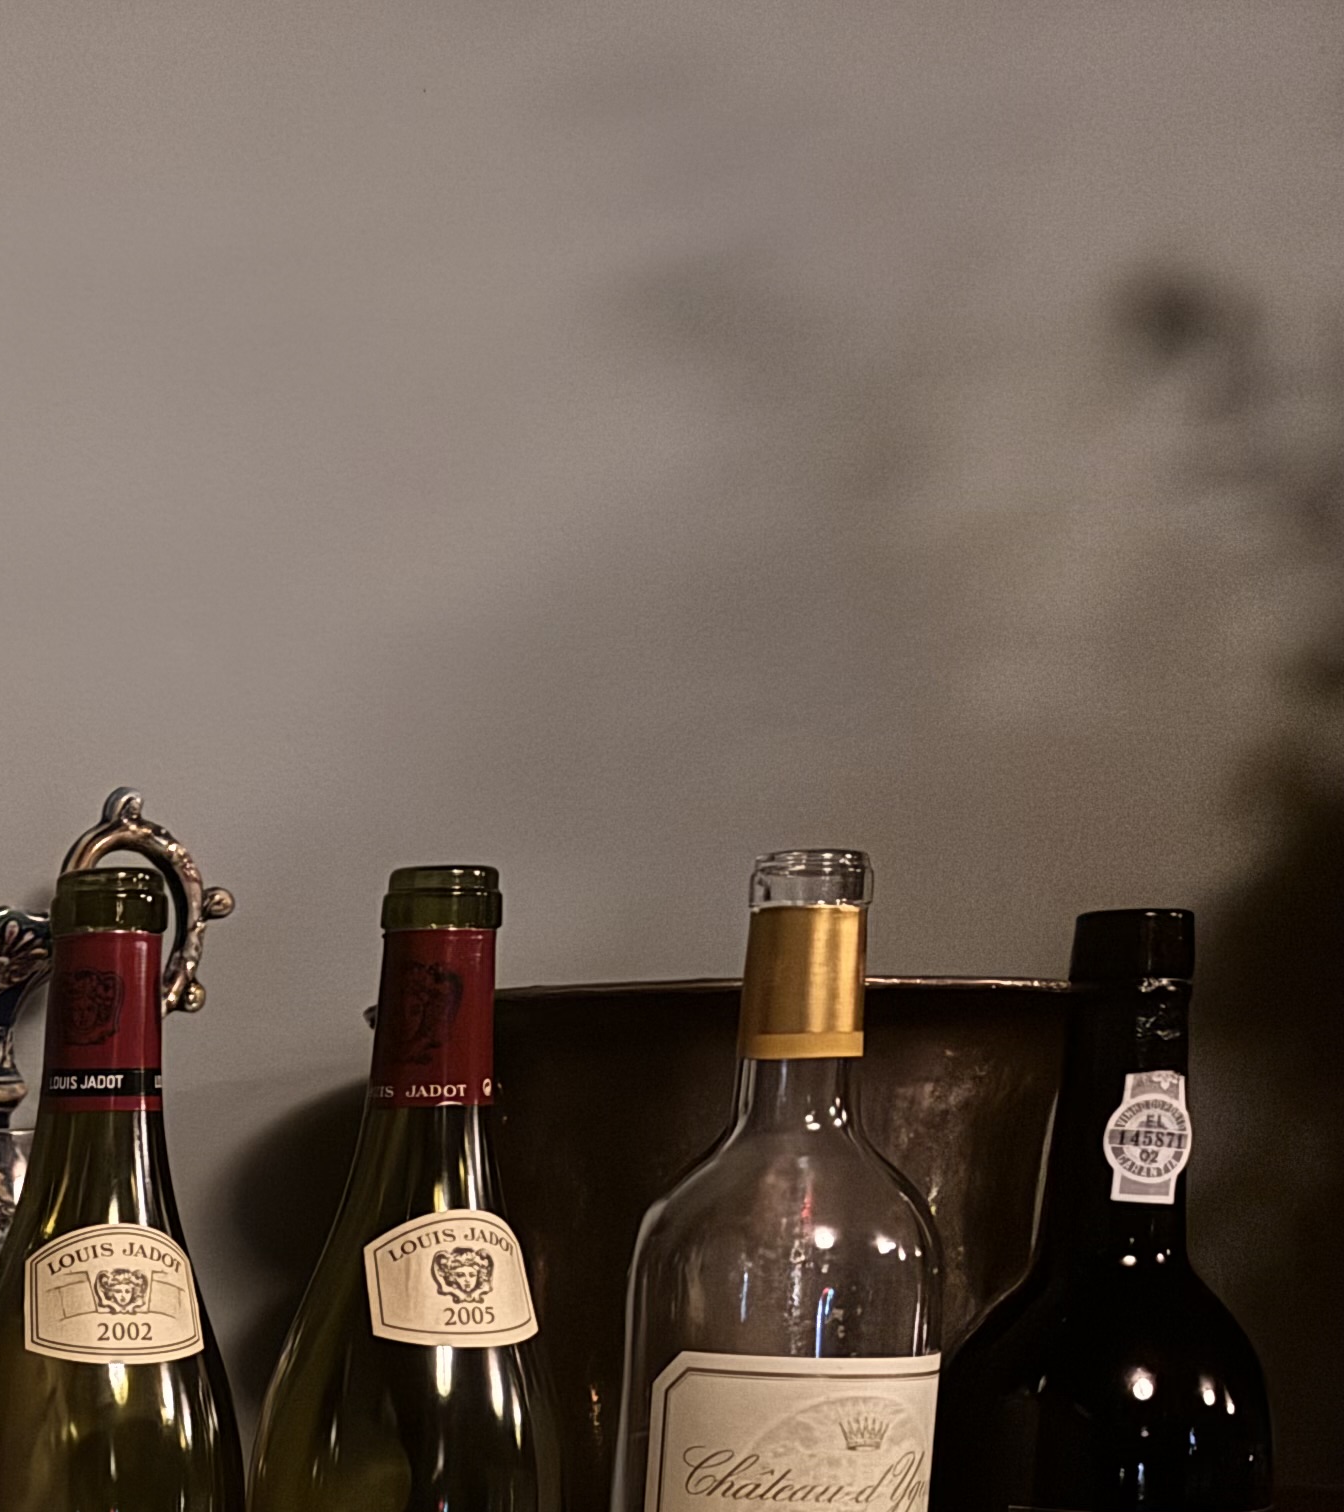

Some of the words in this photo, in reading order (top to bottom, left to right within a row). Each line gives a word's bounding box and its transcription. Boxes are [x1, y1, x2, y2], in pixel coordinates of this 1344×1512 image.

[80, 1074, 124, 1090] JADOT
[405, 1084, 467, 1098] JADOT
[1120, 1129, 1183, 1149] 145871
[388, 1229, 456, 1262] LOUIS
[463, 1228, 514, 1256] JADOT
[47, 1242, 115, 1275] LOUIS
[123, 1242, 181, 1273] JADOT
[444, 1307, 495, 1326] 2005
[97, 1323, 152, 1341] 2002
[683, 1445, 843, 1503] Château
